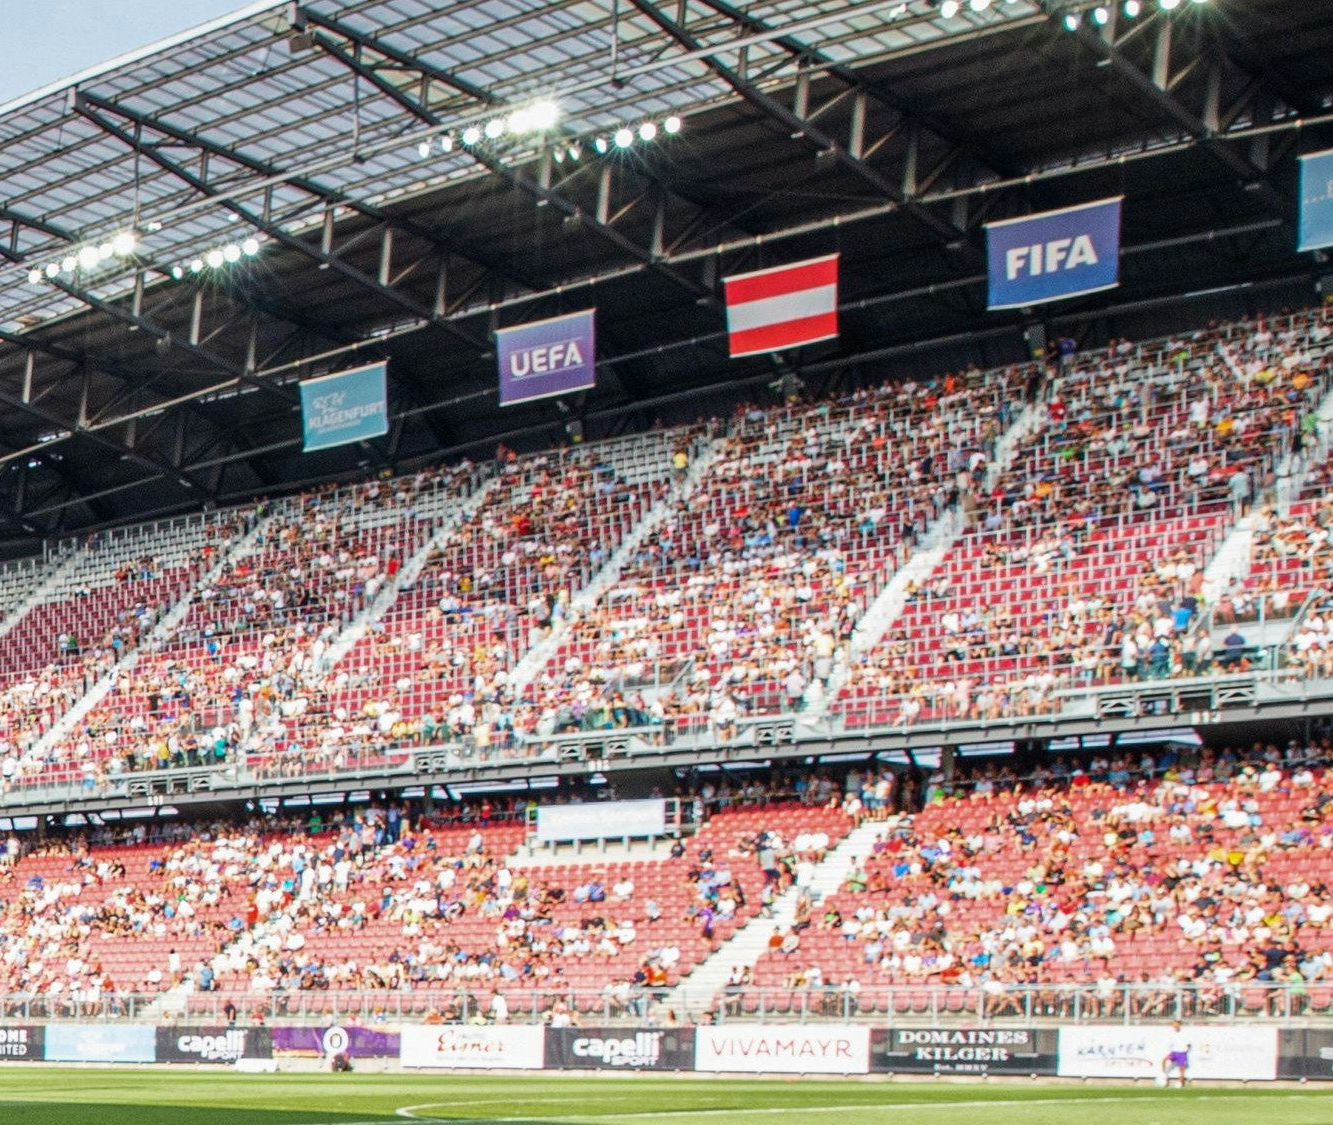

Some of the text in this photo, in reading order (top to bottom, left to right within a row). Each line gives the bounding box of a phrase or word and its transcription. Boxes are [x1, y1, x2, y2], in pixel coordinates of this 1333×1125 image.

[1006, 235, 1099, 281] FIFA
[510, 341, 582, 377] UEFA
[308, 400, 386, 429] KLAGENFURT
[177, 1029, 245, 1058] capelli
[572, 1032, 660, 1063] capelli
[711, 1039, 852, 1058] VIVAMAYR
[898, 1030, 1029, 1044] DOMAINES
[916, 1048, 1009, 1061] KILGER
